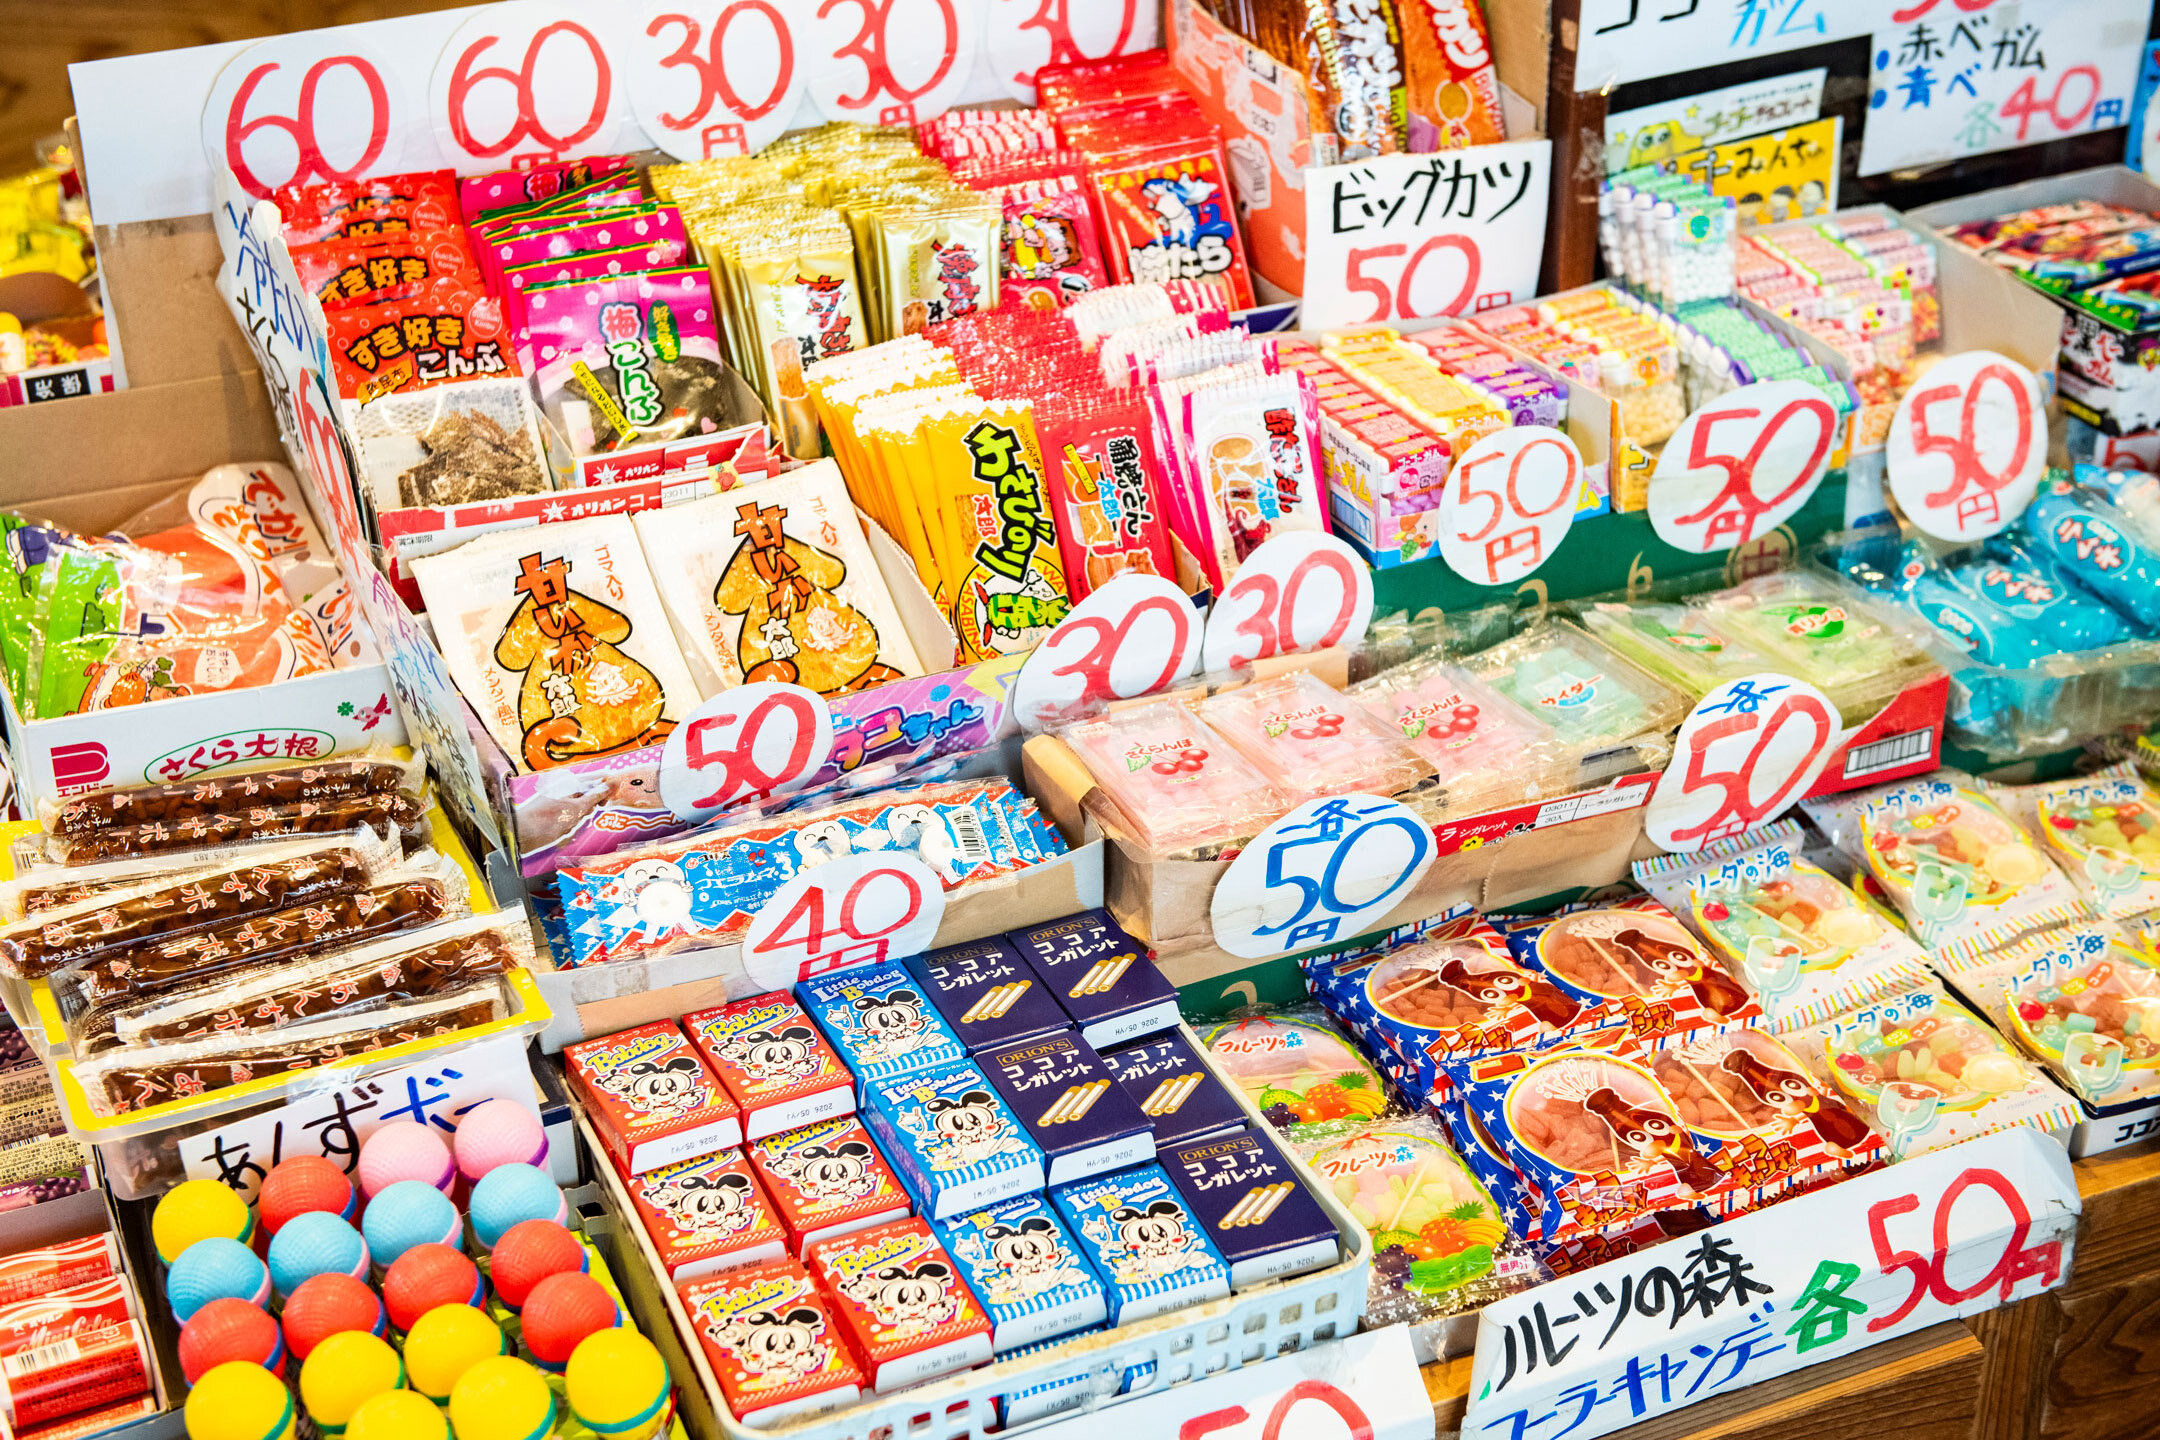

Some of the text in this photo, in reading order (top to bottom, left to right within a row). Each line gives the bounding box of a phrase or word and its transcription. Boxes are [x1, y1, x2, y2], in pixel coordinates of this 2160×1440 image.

[645, 1, 795, 131] 30
[816, 0, 958, 108] 30
[448, 20, 611, 159] 60
[1956, 65, 2124, 150] 各 40 円
[226, 54, 390, 200] 60
[1333, 159, 1532, 233] ビッグカツ
[1346, 233, 1482, 325] 50
[344, 314, 465, 374] すき好き
[416, 343, 506, 380] こんぶ
[603, 304, 662, 424] 梅こんぶ
[1397, 448, 1444, 467] ゴーゴーガム
[1910, 364, 2033, 531] 50 円
[625, 463, 660, 478] オリオン
[1674, 399, 1837, 550] 50 円
[571, 497, 627, 517] オリオン
[970, 422, 1055, 583] わさびのり
[973, 494, 998, 538] 太郎
[1097, 479, 1122, 520] 太郎
[1255, 477, 1281, 521] 太郎
[1458, 438, 1577, 583] 50 円
[594, 543, 625, 602] ゴマ入り
[733, 500, 816, 620] 甘いか
[514, 551, 600, 677] 甘いか
[1229, 550, 1360, 672] 30
[758, 616, 801, 662] 太郎
[1036, 596, 1190, 721] 30
[540, 673, 583, 718] 太郎
[1540, 672, 1607, 708] サイダー
[1728, 681, 1768, 714] 各
[159, 732, 322, 782] さくら大根
[685, 691, 817, 806] 50
[1672, 694, 1831, 843] 50
[57, 784, 115, 798] エンドー
[1544, 801, 1575, 814] 03011
[1580, 790, 1645, 812] コーラシガレット
[1854, 781, 1954, 823] ソーダの海
[1312, 799, 1361, 842] 各
[1458, 821, 1508, 839] シガレット
[1252, 816, 1429, 937] 50
[1686, 845, 1791, 899] ソーダの海
[753, 868, 922, 980] 40 円
[1031, 918, 1099, 942] ORION'S
[1033, 926, 1107, 954] ココア
[1284, 916, 1342, 951] 円
[927, 945, 997, 966] ORION'S
[928, 952, 1004, 980] ココア
[1044, 937, 1119, 966] シガレット
[1998, 929, 2106, 993] ソーダの海
[810, 969, 908, 1004] Little Bobdog
[938, 963, 1016, 991] シガレット
[707, 1002, 791, 1042] Bobdog
[733, 998, 758, 1010] コーラ
[1819, 992, 1934, 1042] ソーダの海
[590, 1033, 673, 1075] Bobdog
[616, 1028, 641, 1041] コーラ
[1001, 1039, 1072, 1064] ORION'S
[1216, 1029, 1306, 1056] フルーツの森
[1002, 1049, 1081, 1079] ココア
[1012, 1061, 1093, 1092] シガレット
[881, 1068, 983, 1106] Little Bobdog
[757, 1116, 849, 1156] Bobdog
[1182, 1137, 1254, 1163] ORION'S
[1183, 1148, 1264, 1178] ココア
[1194, 1162, 1277, 1192] シガレット
[1322, 1144, 1417, 1180] フルーツの森
[1065, 1174, 1170, 1213] Little Bobdog
[864, 1228, 890, 1240] コーラ
[830, 1234, 920, 1278] Bobdog
[1786, 1167, 2064, 1356] 各 50 円
[701, 1277, 793, 1321] Bobdog
